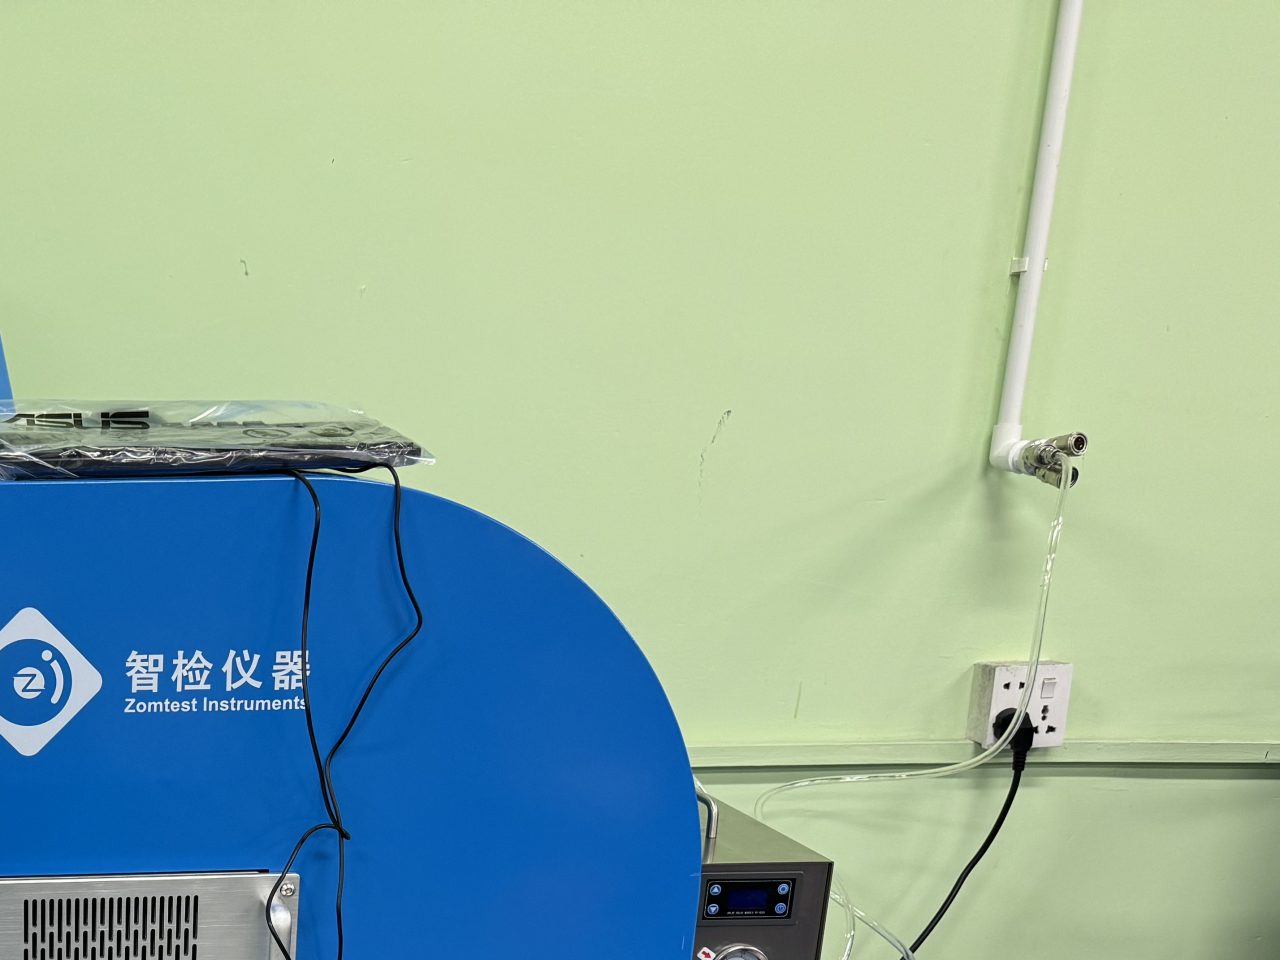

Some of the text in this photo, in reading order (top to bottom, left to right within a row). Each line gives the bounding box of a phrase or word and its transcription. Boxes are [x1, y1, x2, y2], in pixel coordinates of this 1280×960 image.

[1, 410, 151, 430] ASUS
[124, 649, 310, 693] 智检仪器
[124, 695, 306, 713] Zomtest Instruments
